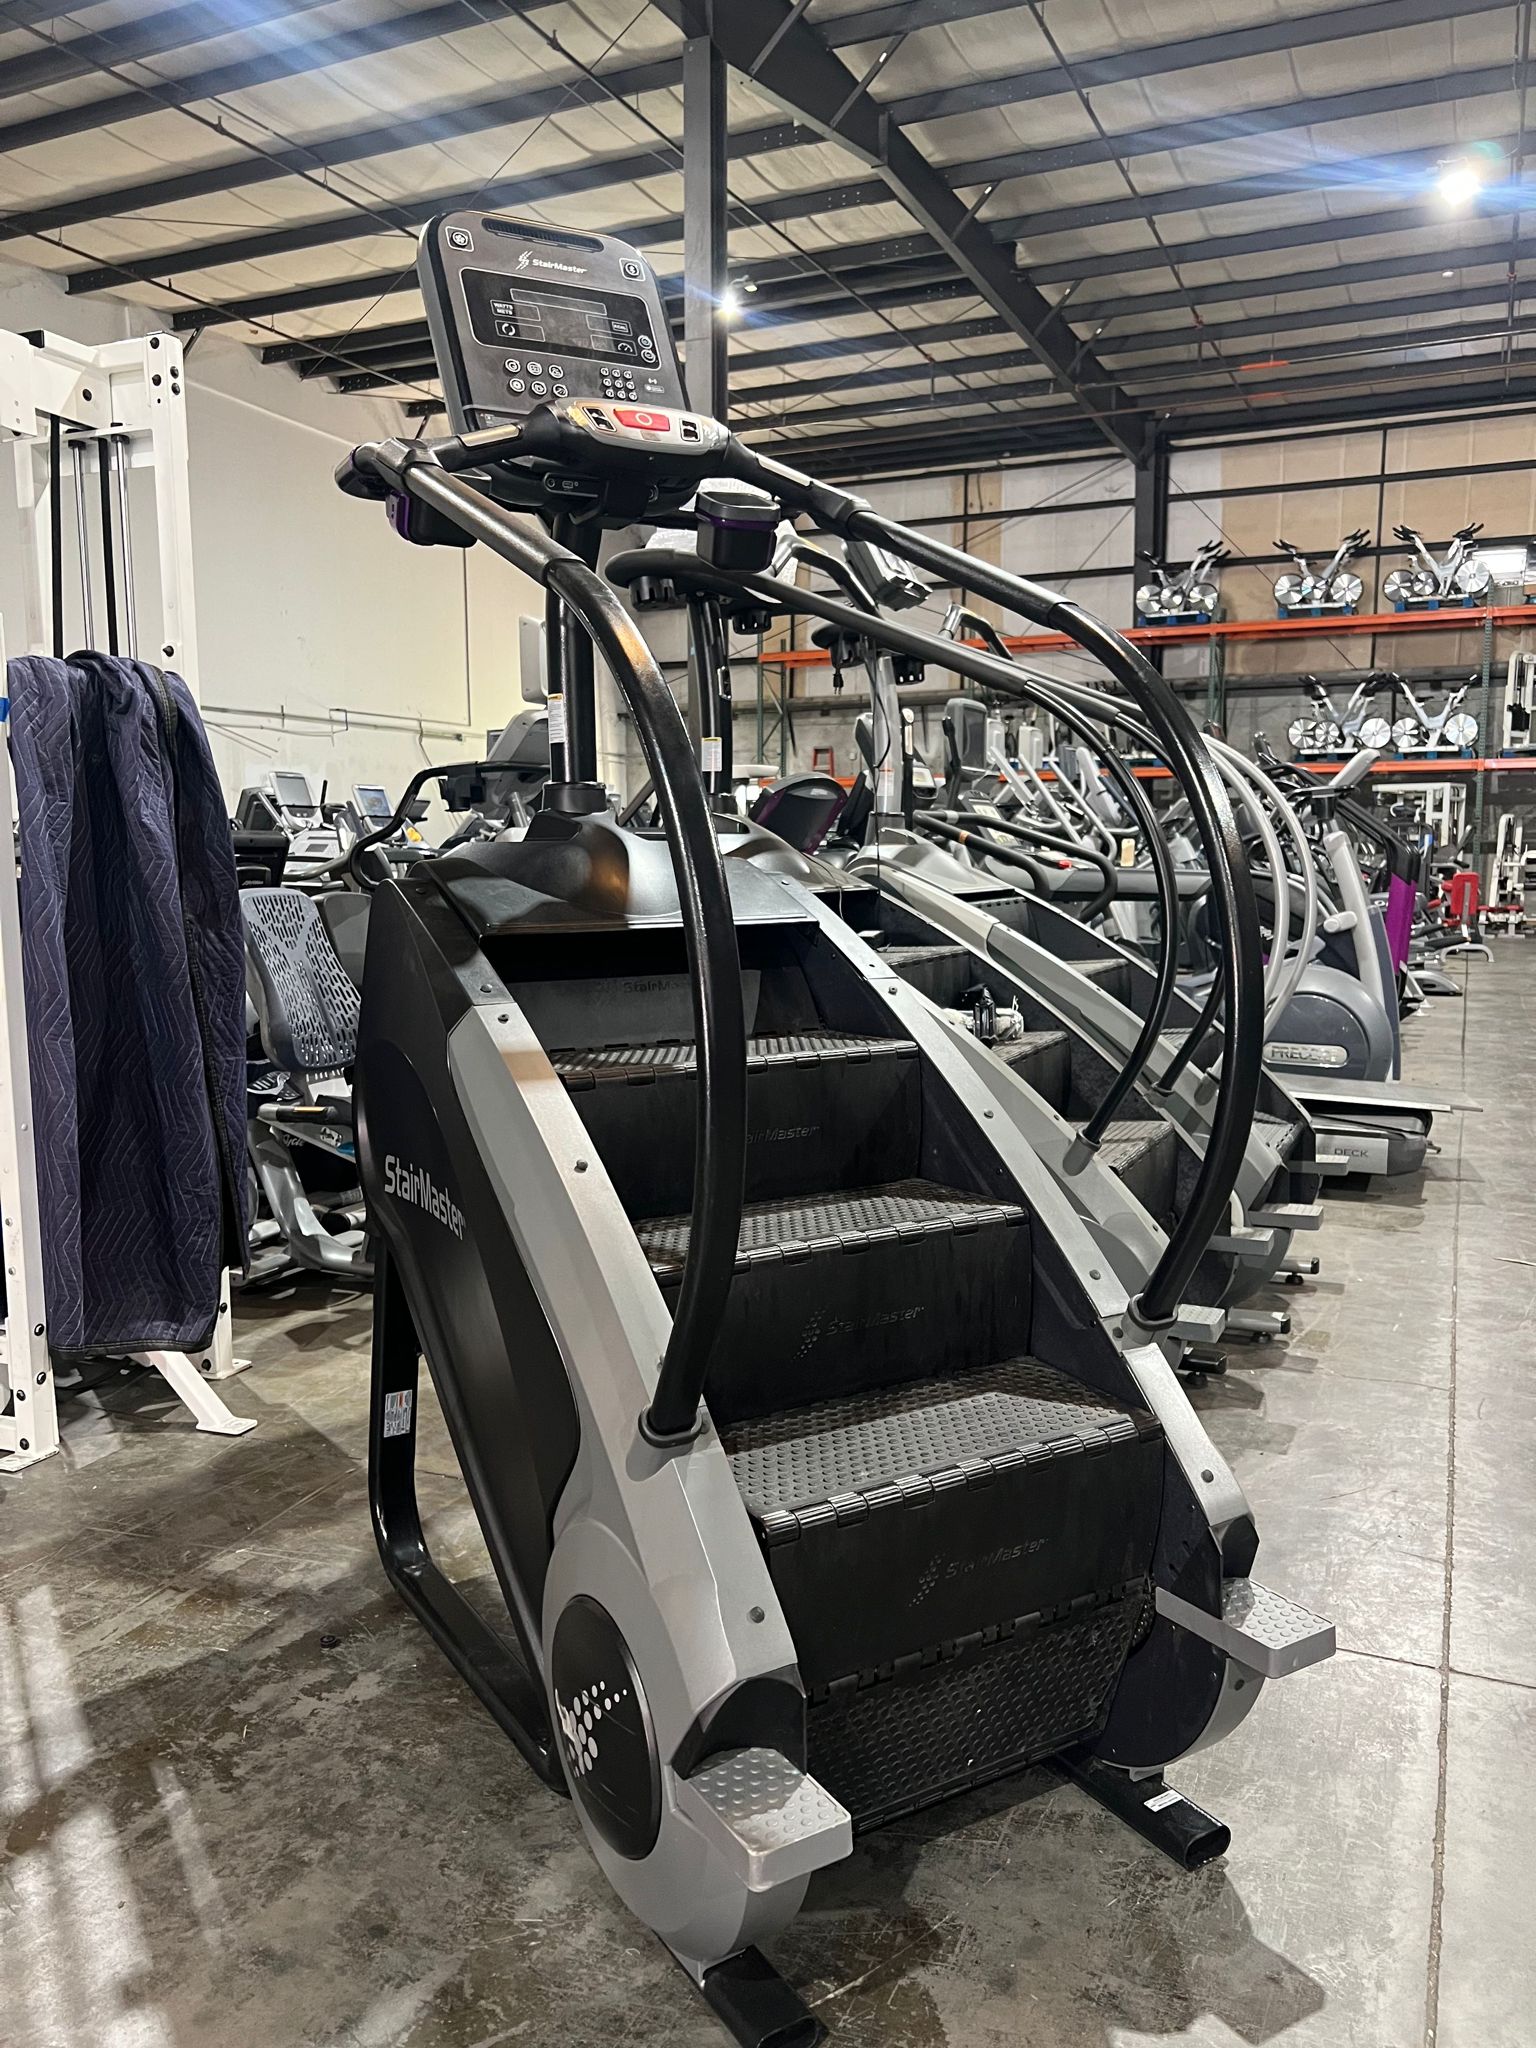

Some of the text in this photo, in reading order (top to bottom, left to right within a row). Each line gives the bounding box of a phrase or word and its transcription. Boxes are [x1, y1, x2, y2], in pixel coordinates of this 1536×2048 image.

[532, 258, 587, 274] StairMaster
[746, 1125, 820, 1144] airMaster
[384, 1154, 467, 1241] StairMaster
